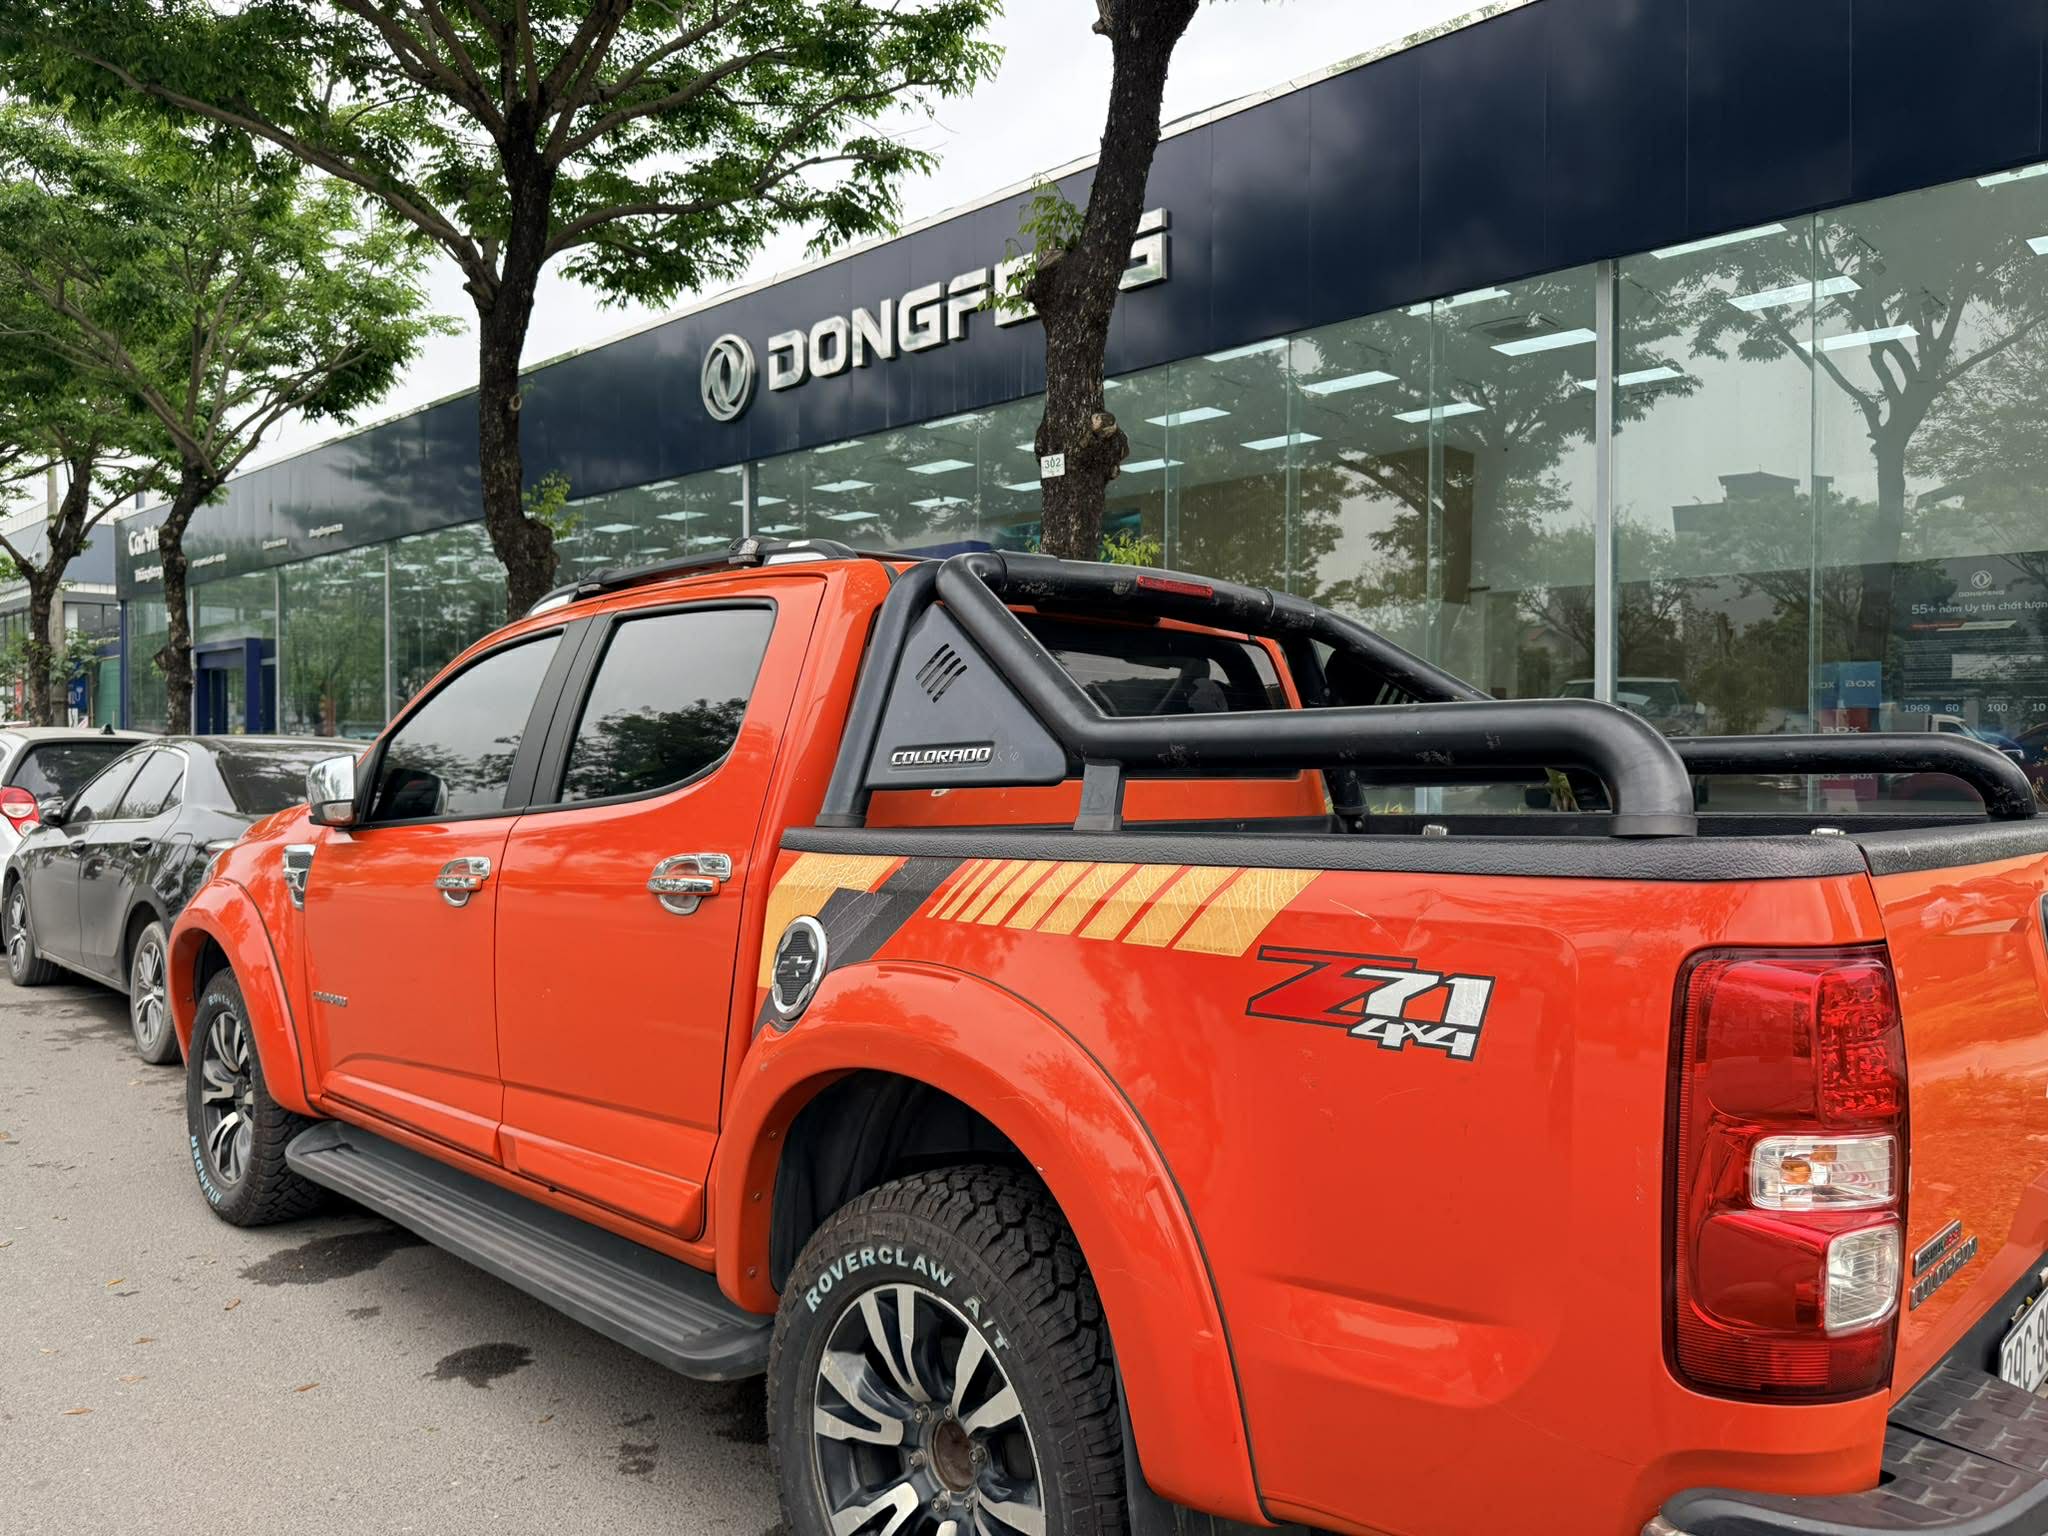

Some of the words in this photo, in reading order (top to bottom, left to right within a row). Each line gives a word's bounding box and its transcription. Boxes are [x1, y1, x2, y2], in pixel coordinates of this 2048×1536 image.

[768, 207, 1168, 392] DONGFEG
[1045, 457, 1061, 469] 302
[1911, 603, 1936, 615] 55+
[1964, 603, 1979, 614] Uy
[1845, 680, 1876, 688] BOX
[1904, 703, 1931, 713] 1969
[1945, 703, 1960, 713] 60
[1986, 703, 2009, 713] 100
[891, 747, 991, 765] COLORADO
[1245, 944, 1496, 1029] Z71
[191, 1135, 222, 1205] ATLANDER
[805, 1246, 956, 1313] ROVERCLAW
